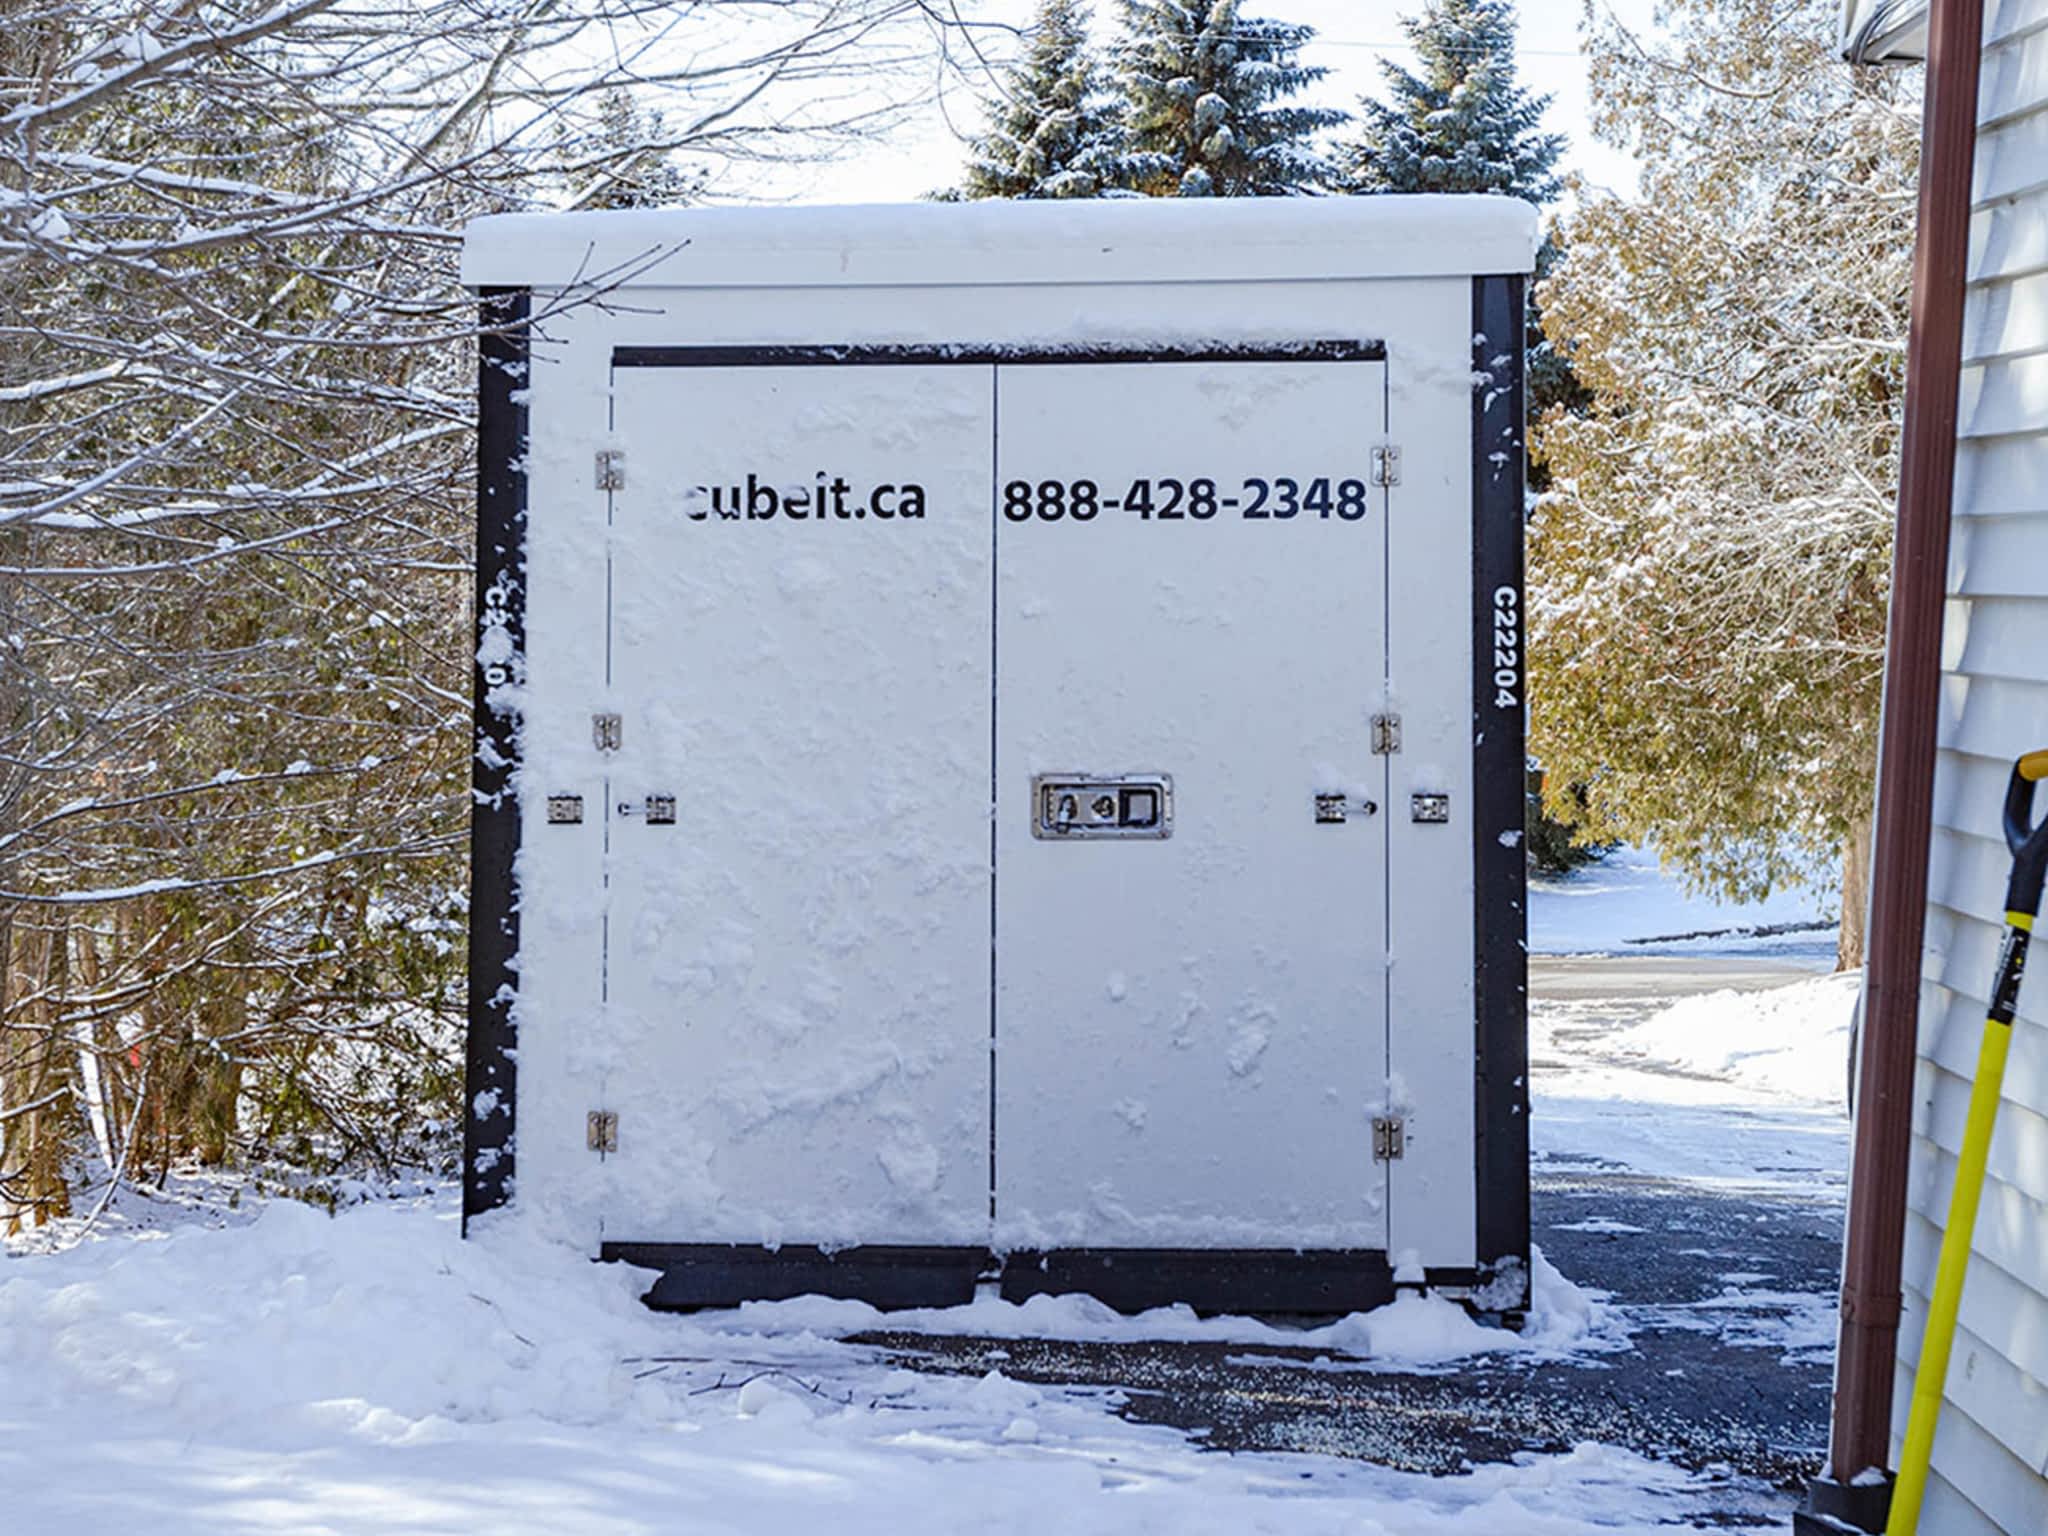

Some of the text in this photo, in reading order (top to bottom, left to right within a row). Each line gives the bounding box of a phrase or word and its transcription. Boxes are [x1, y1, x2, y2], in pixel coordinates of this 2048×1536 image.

[1003, 477, 1366, 523] 888-428-2348
[485, 586, 507, 705] C20
[1494, 586, 1518, 708] C22204
